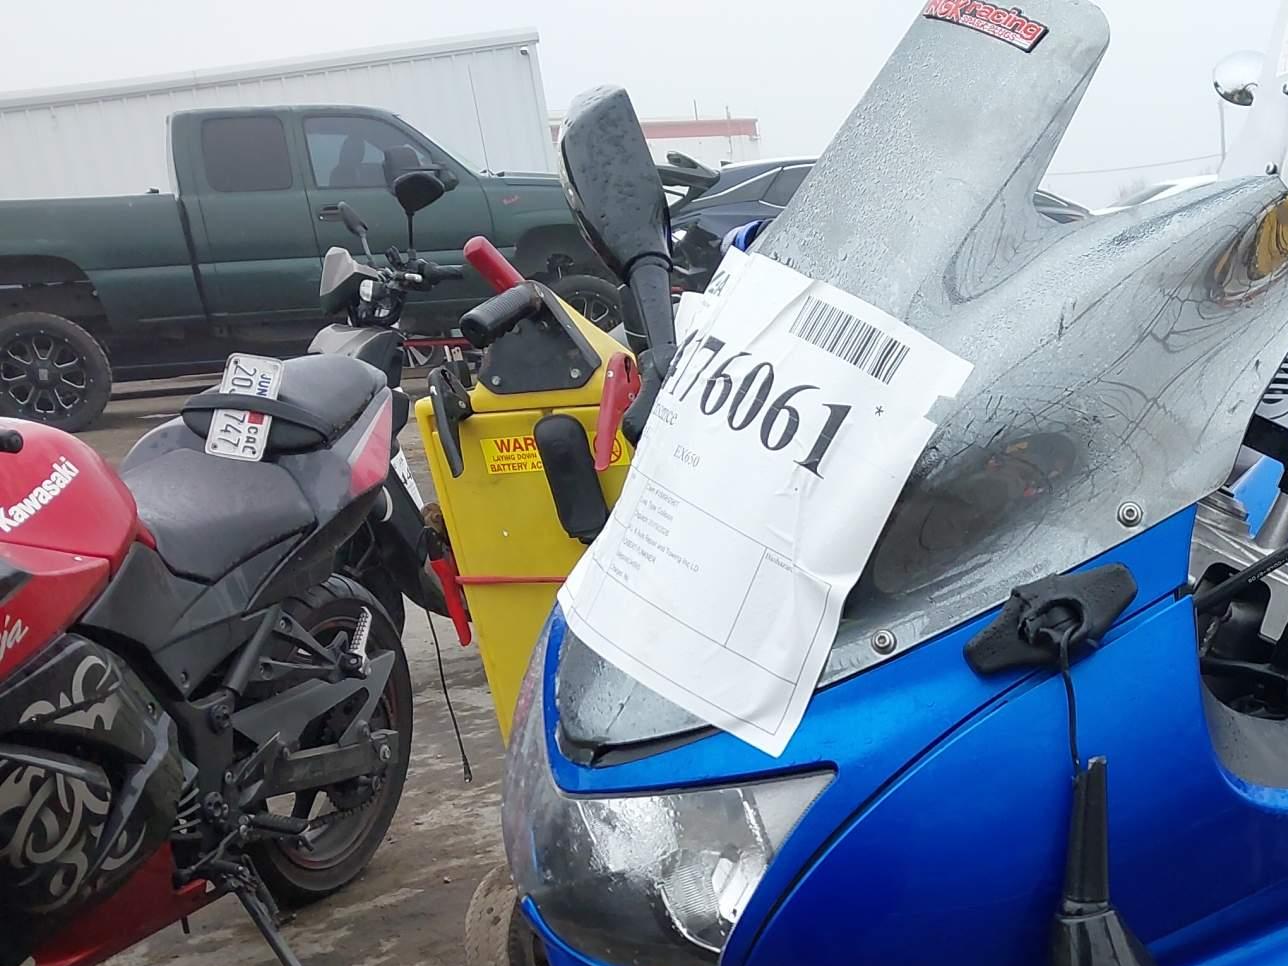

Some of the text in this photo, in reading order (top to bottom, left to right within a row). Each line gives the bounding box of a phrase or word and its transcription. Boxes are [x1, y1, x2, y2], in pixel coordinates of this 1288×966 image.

[966, 1, 1041, 41] racing
[256, 373, 271, 397] JUN
[490, 461, 529, 473] BATTERY
[672, 443, 701, 469] EX650
[0, 456, 80, 533] Kawasaki
[0, 614, 29, 664] ja
